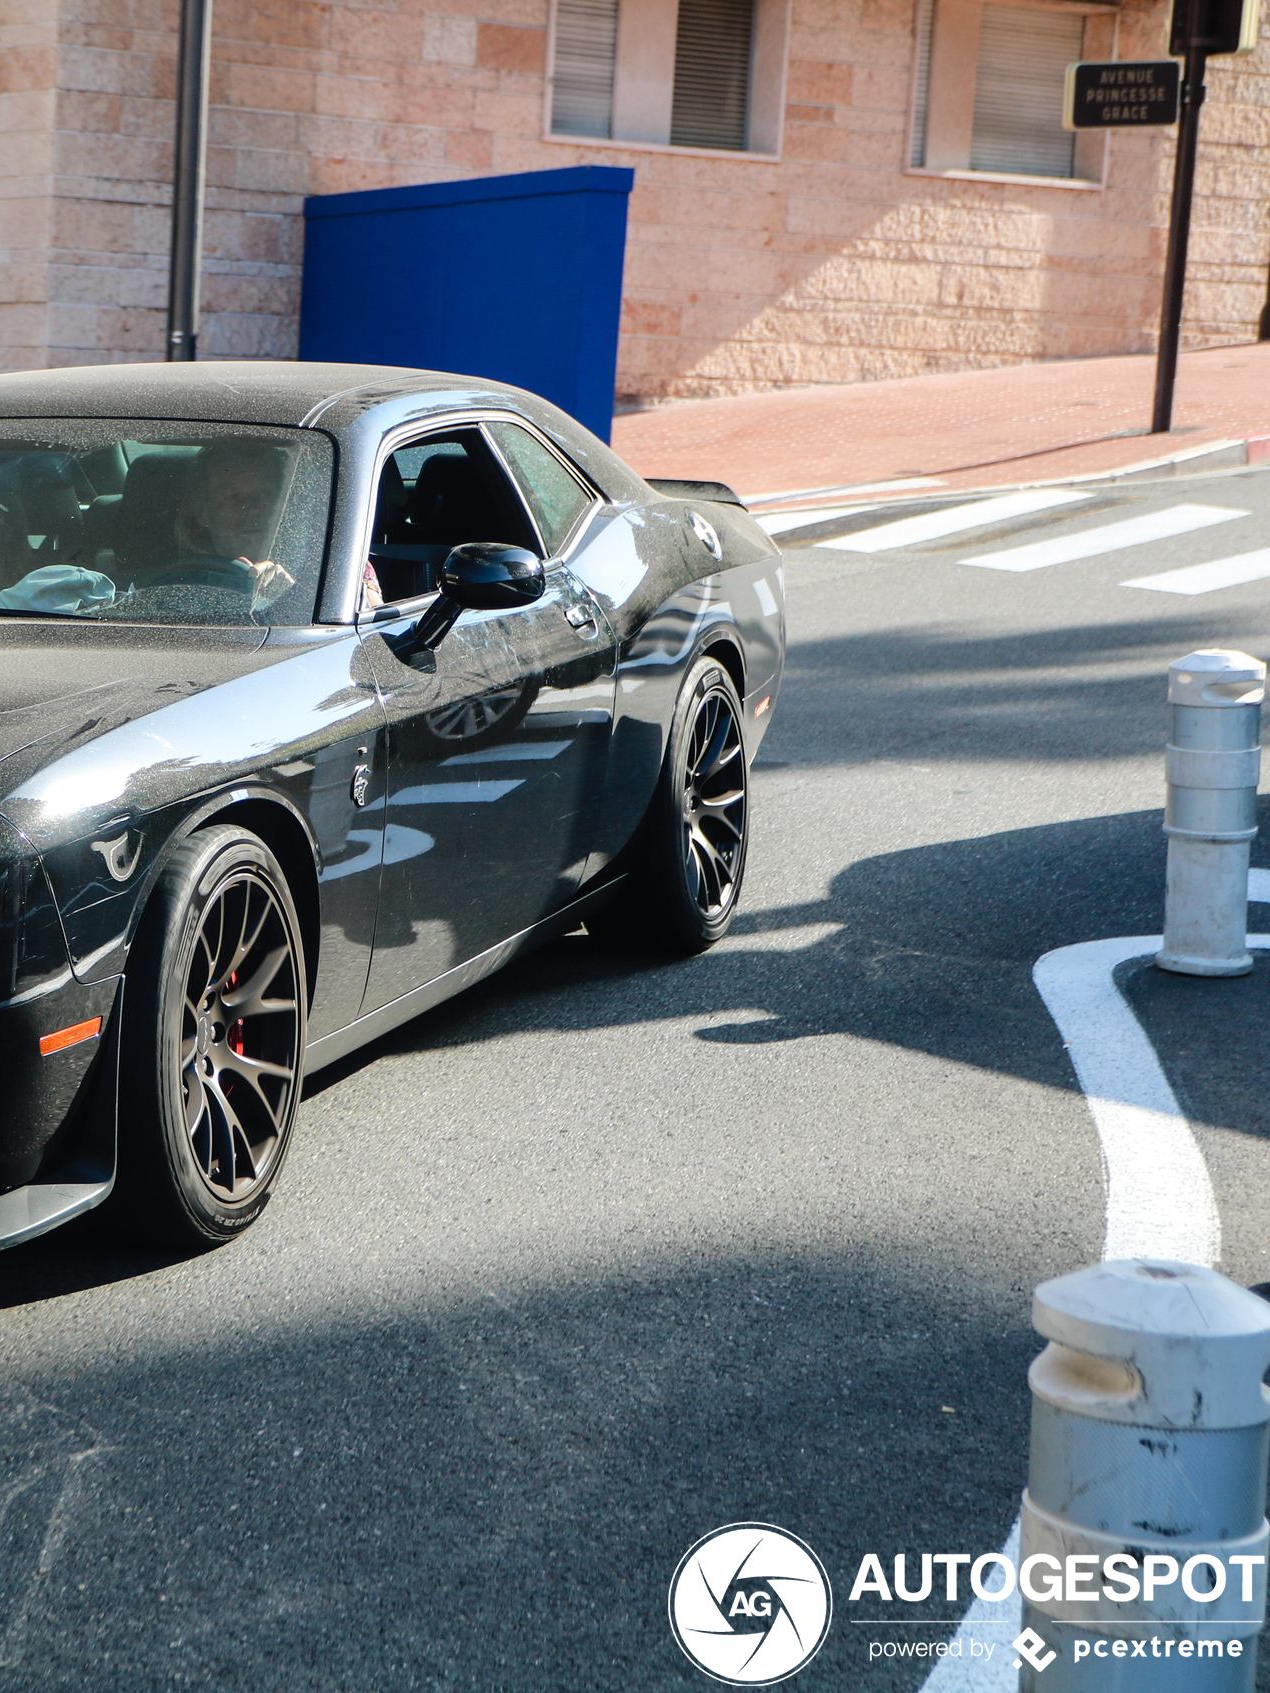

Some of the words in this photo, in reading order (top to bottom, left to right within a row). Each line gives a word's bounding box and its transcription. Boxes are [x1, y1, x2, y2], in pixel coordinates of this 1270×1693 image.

[1100, 69, 1154, 84] AVENUE
[1086, 86, 1165, 103] PRINCESSE
[1102, 105, 1149, 121] GRACE
